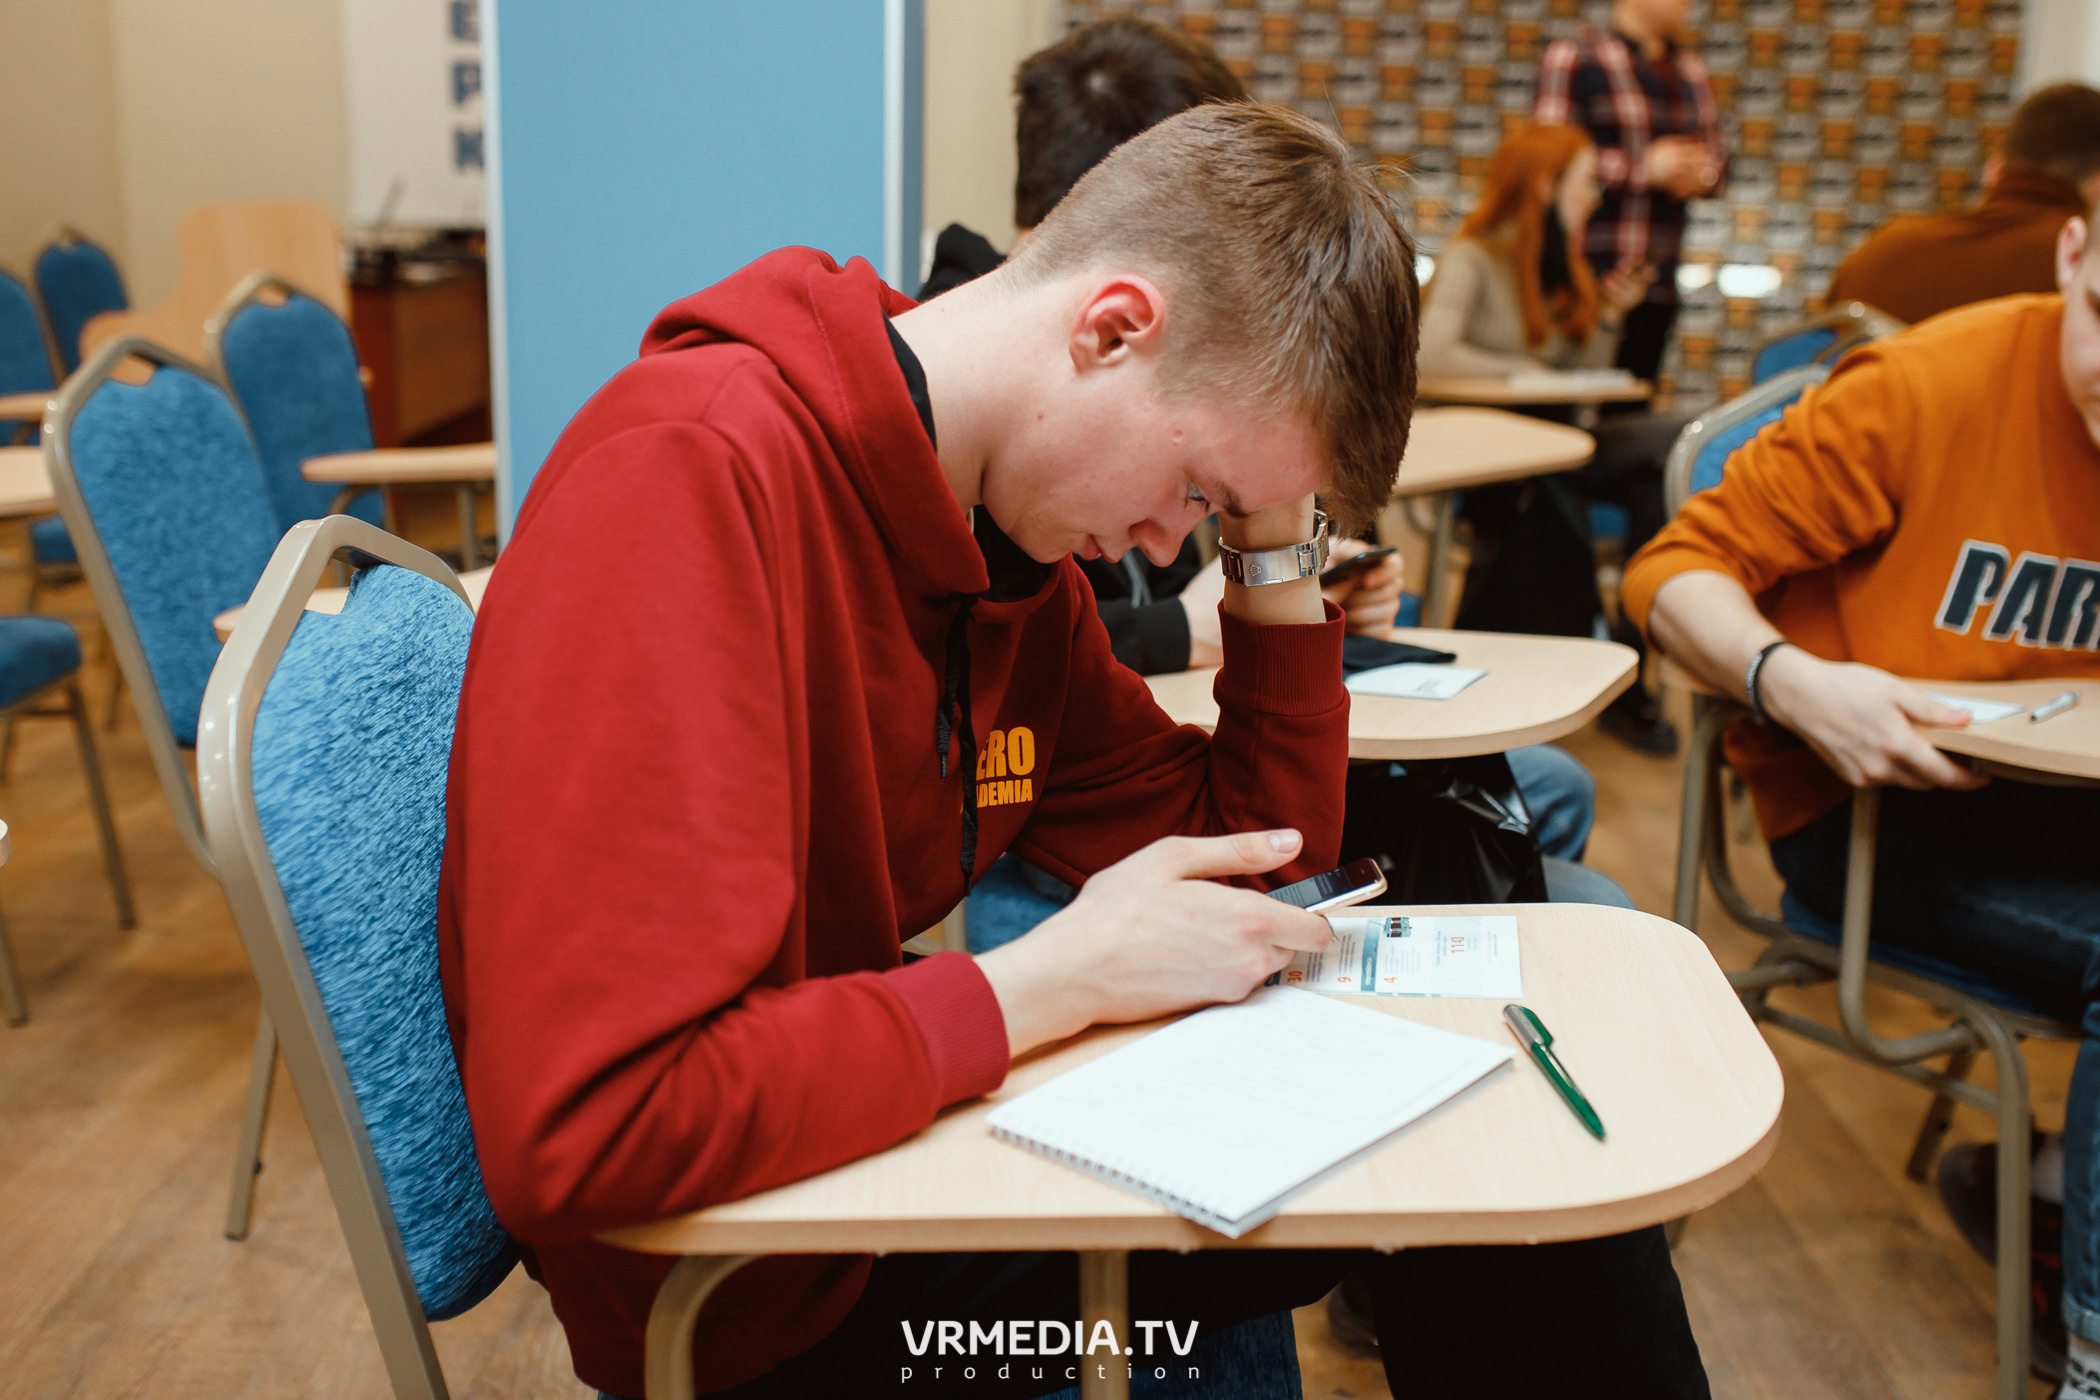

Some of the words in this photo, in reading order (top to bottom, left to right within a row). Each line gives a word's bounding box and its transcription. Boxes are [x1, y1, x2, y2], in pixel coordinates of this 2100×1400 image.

[1934, 538, 2100, 651] PAR
[976, 779, 1034, 808] DEMIA
[1287, 970, 1303, 983] 30
